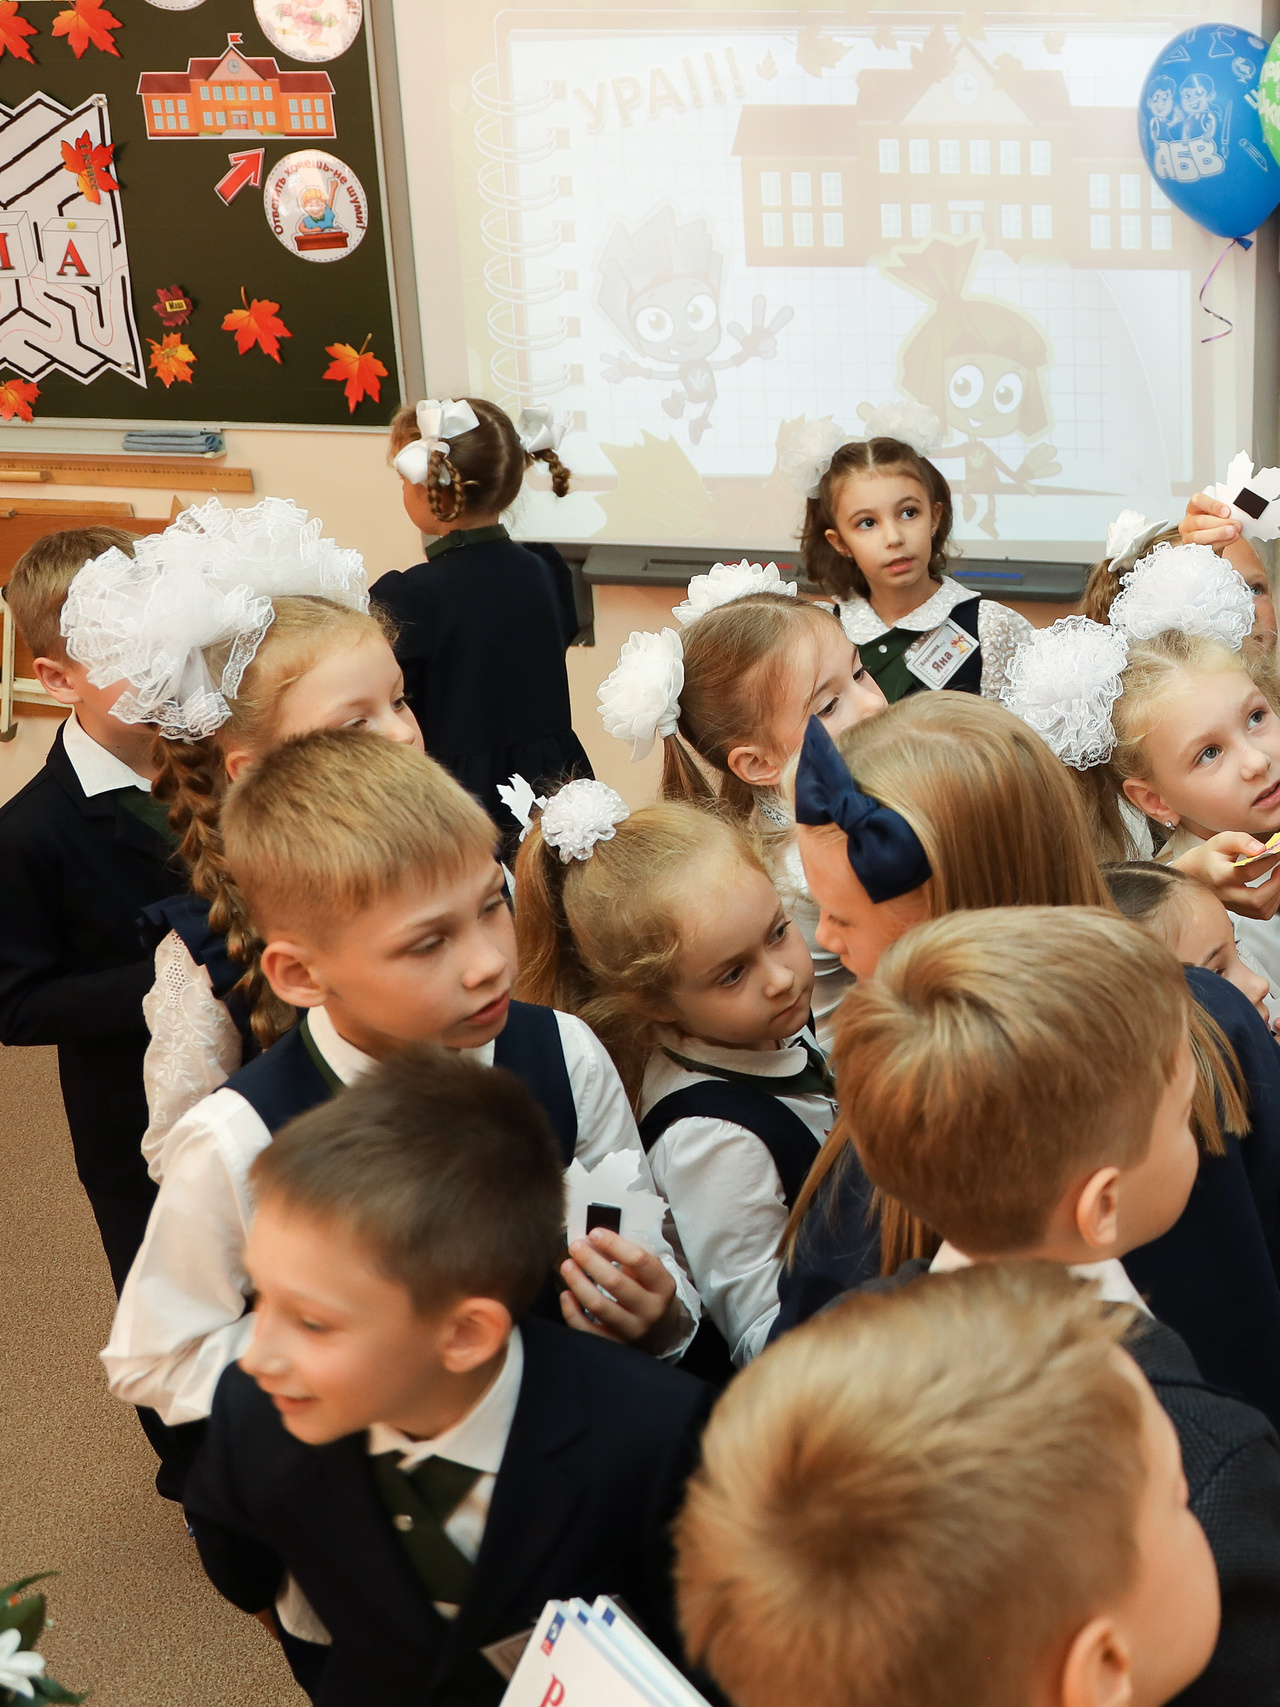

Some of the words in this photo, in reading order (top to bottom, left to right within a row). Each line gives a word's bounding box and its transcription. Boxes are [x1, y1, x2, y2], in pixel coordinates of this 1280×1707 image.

[572, 46, 744, 132] УРА!!!
[1154, 136, 1226, 183] АБВ
[346, 185, 367, 230] шуми!
[931, 651, 954, 674] Яна
